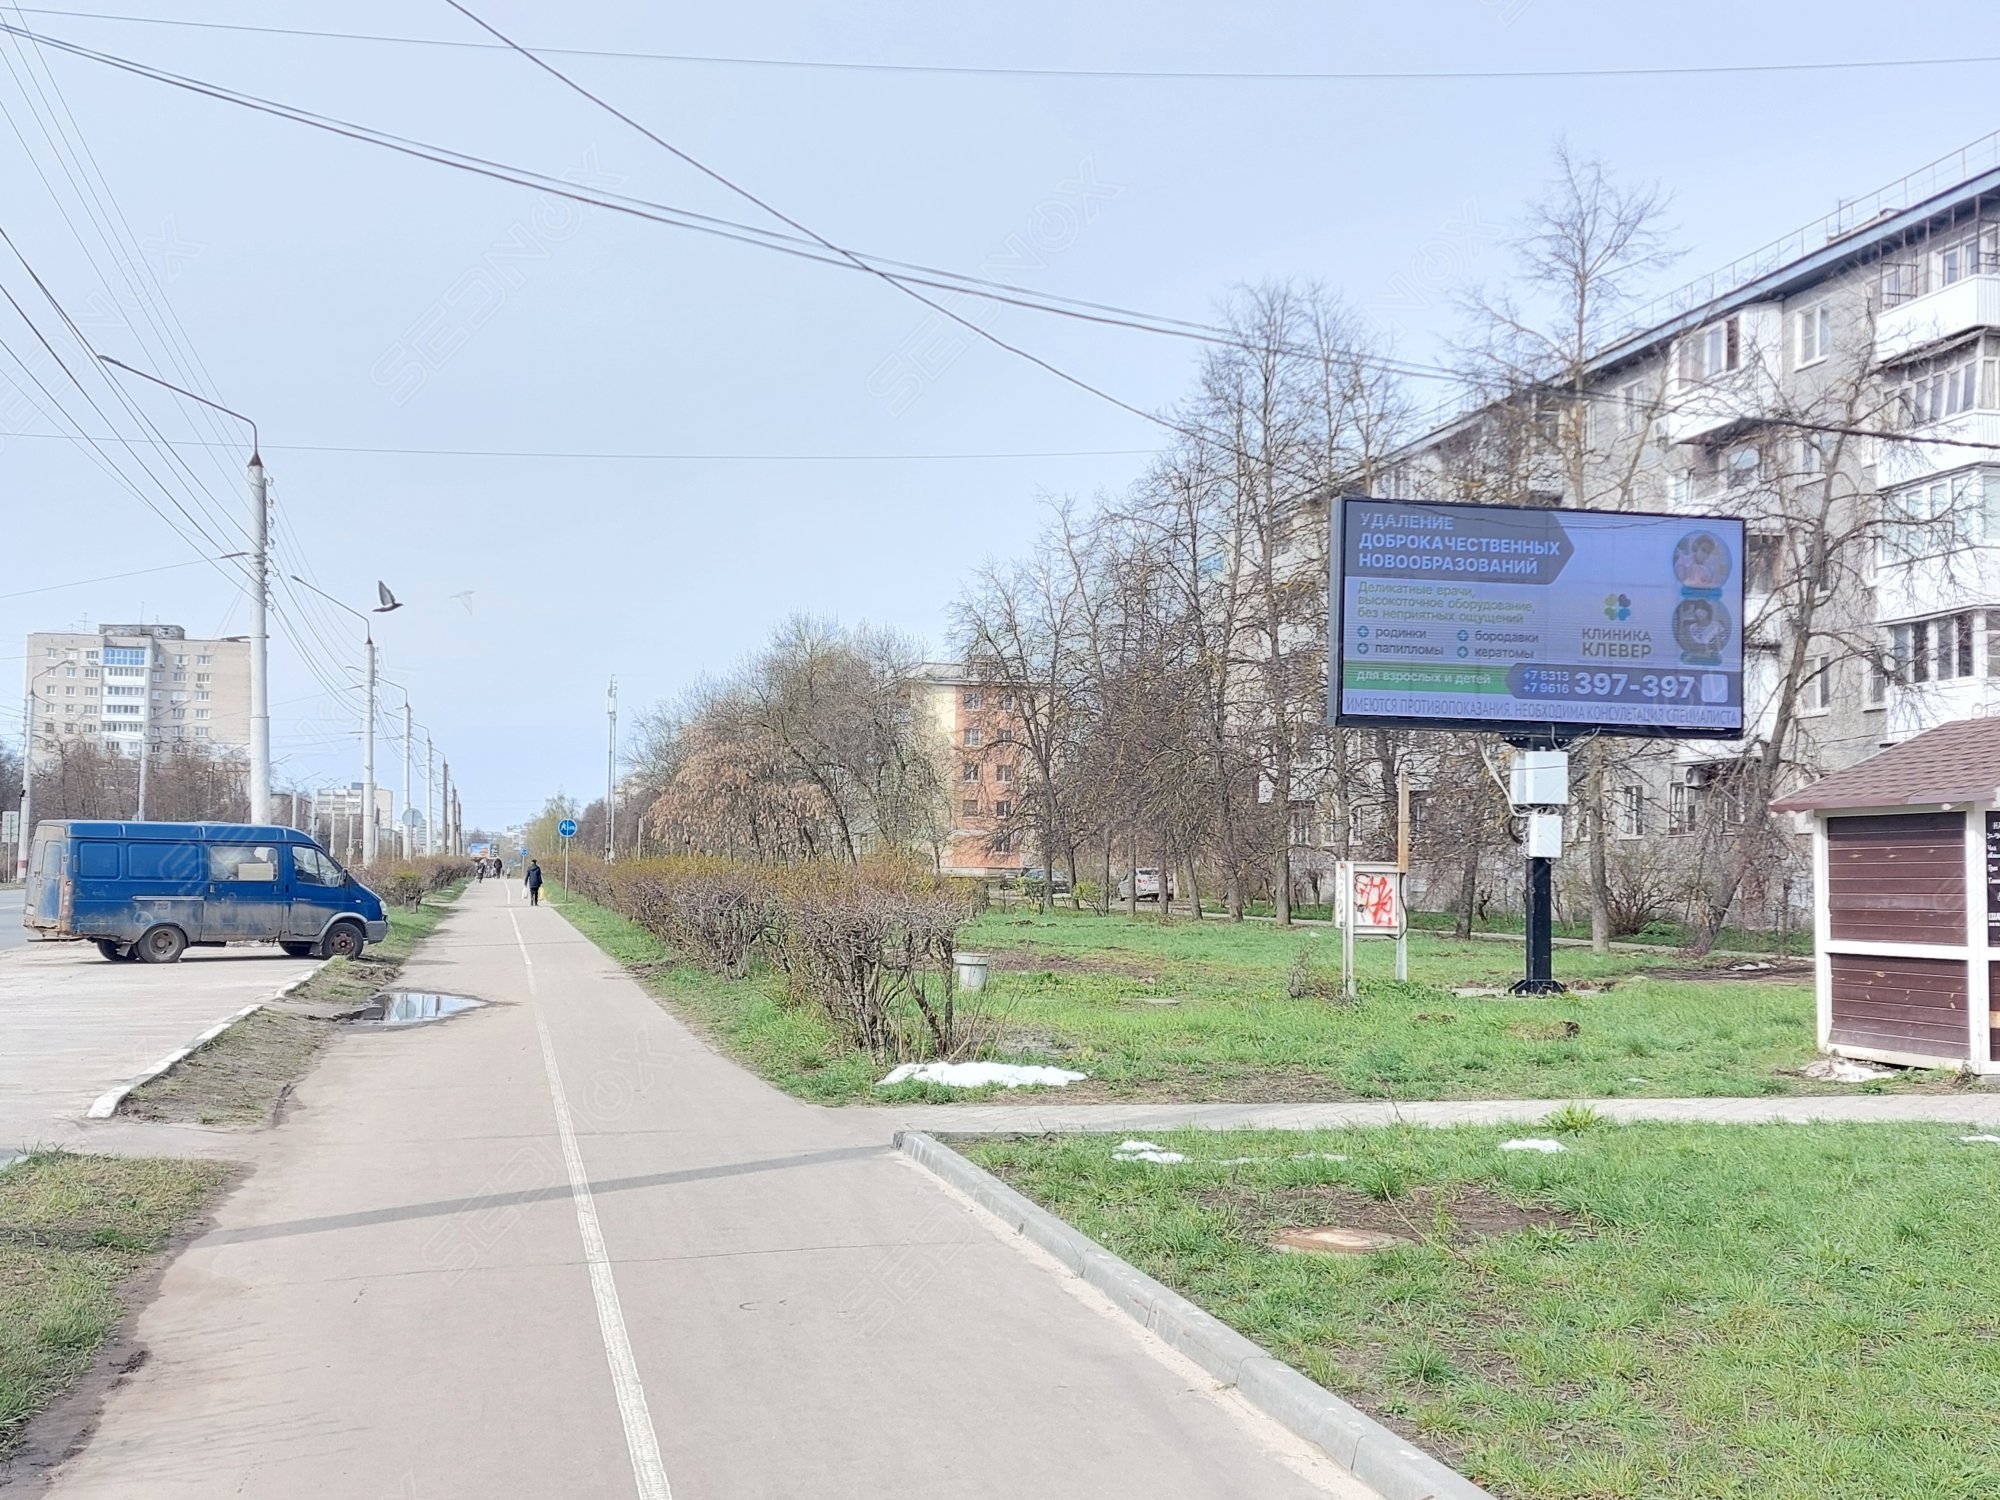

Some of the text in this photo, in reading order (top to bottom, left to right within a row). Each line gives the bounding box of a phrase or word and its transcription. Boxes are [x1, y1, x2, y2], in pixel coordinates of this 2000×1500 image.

[1361, 513, 1454, 530] УДАЛЕНИЕ
[1359, 533, 1561, 555] ДОБРОКАЧЕСТВЕННЫХ
[1359, 553, 1538, 574] НОВООБРАЗОВАНИЙ
[1358, 582, 1476, 598] Деликатные врачи,
[1358, 596, 1536, 613] высокоточное оборудование,
[1358, 606, 1524, 625] без неприятных ощущений
[1375, 628, 1427, 640] родинки
[1475, 630, 1540, 644] бородавки
[1582, 628, 1652, 642] КЛИНИКА
[1375, 643, 1444, 656] папилломы
[1475, 647, 1535, 660] кератомы
[1582, 642, 1652, 658] КЛЕВЕР
[1356, 671, 1491, 685] для взрослых и детей
[1523, 670, 1570, 682] +7 8313
[1523, 682, 1570, 694] +7 9616
[1574, 671, 1696, 698] 397-397
[1346, 697, 1398, 714] ИМЕЮТСЯ
[1515, 703, 1585, 720] НЕОБХОДИМА
[1586, 705, 1664, 723] КОНСУЛЬТАЦИЯ
[1666, 707, 1738, 725] СПЕЦИАЛИСТА
